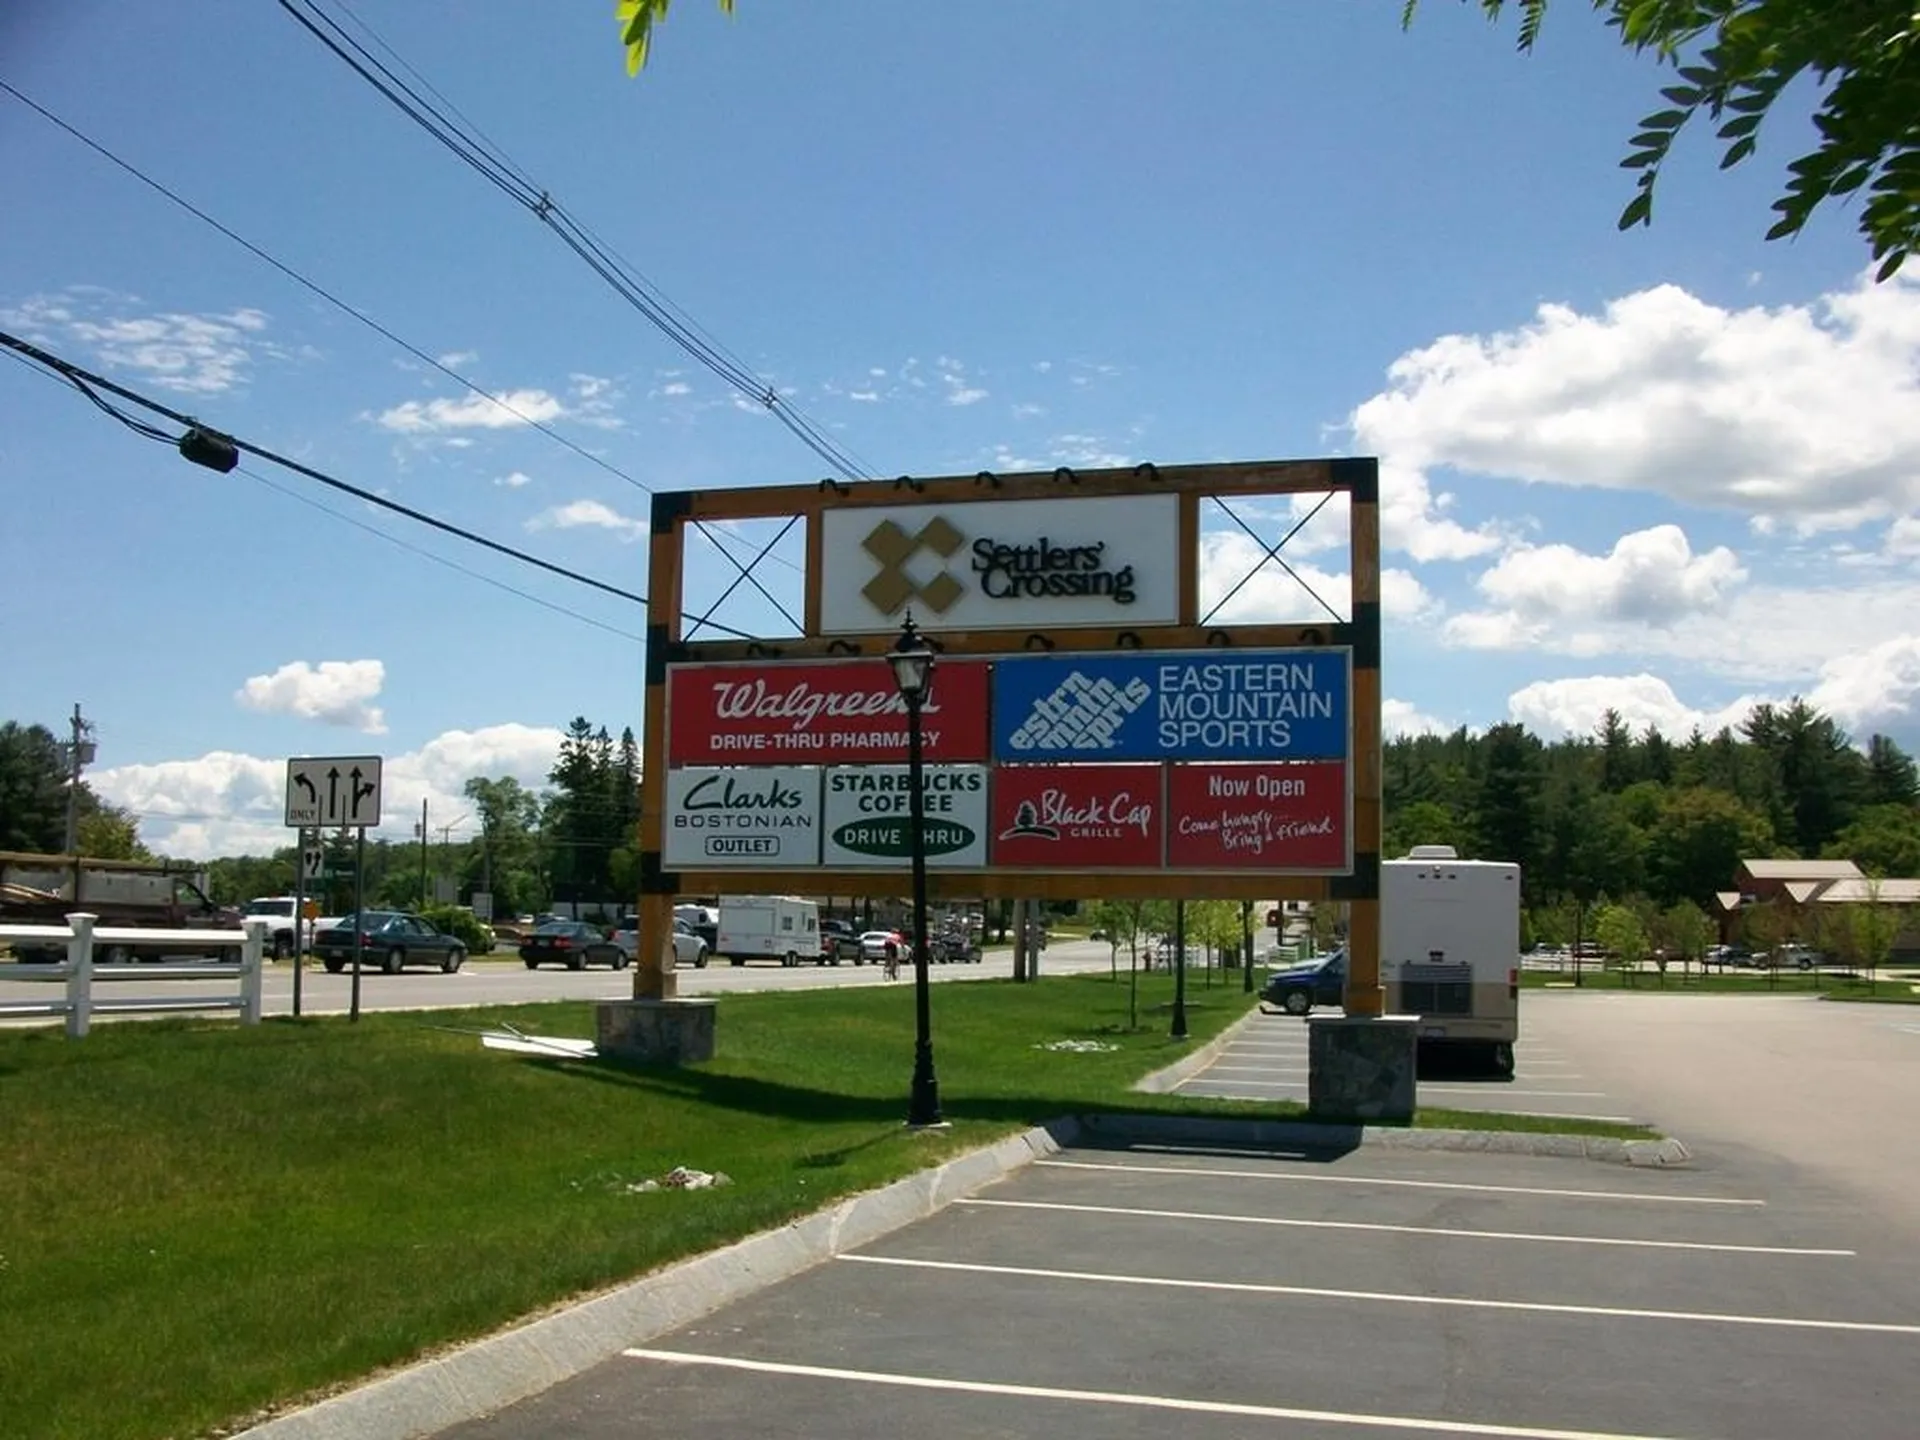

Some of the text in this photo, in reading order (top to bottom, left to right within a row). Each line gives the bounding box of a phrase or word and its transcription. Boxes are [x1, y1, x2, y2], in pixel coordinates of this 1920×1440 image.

[981, 565, 1136, 604] Crossing
[1159, 663, 1314, 692] EASTERN
[1159, 691, 1332, 720] MOUNTAIN
[710, 733, 824, 750] DRIVE-THRU
[1158, 720, 1291, 748] SPORTS
[683, 775, 802, 811] Clarks
[1209, 774, 1305, 801] Now Open
[859, 795, 953, 812] COFEE
[1041, 789, 1152, 838] Black Cap
[674, 815, 812, 828] BOSTONIAN
[1070, 827, 1122, 838] GRILLE
[1178, 815, 1219, 834] Come
[713, 839, 772, 852] OUTLET
[844, 828, 963, 844] DRIVE HRU
[1221, 829, 1264, 855] Bring
